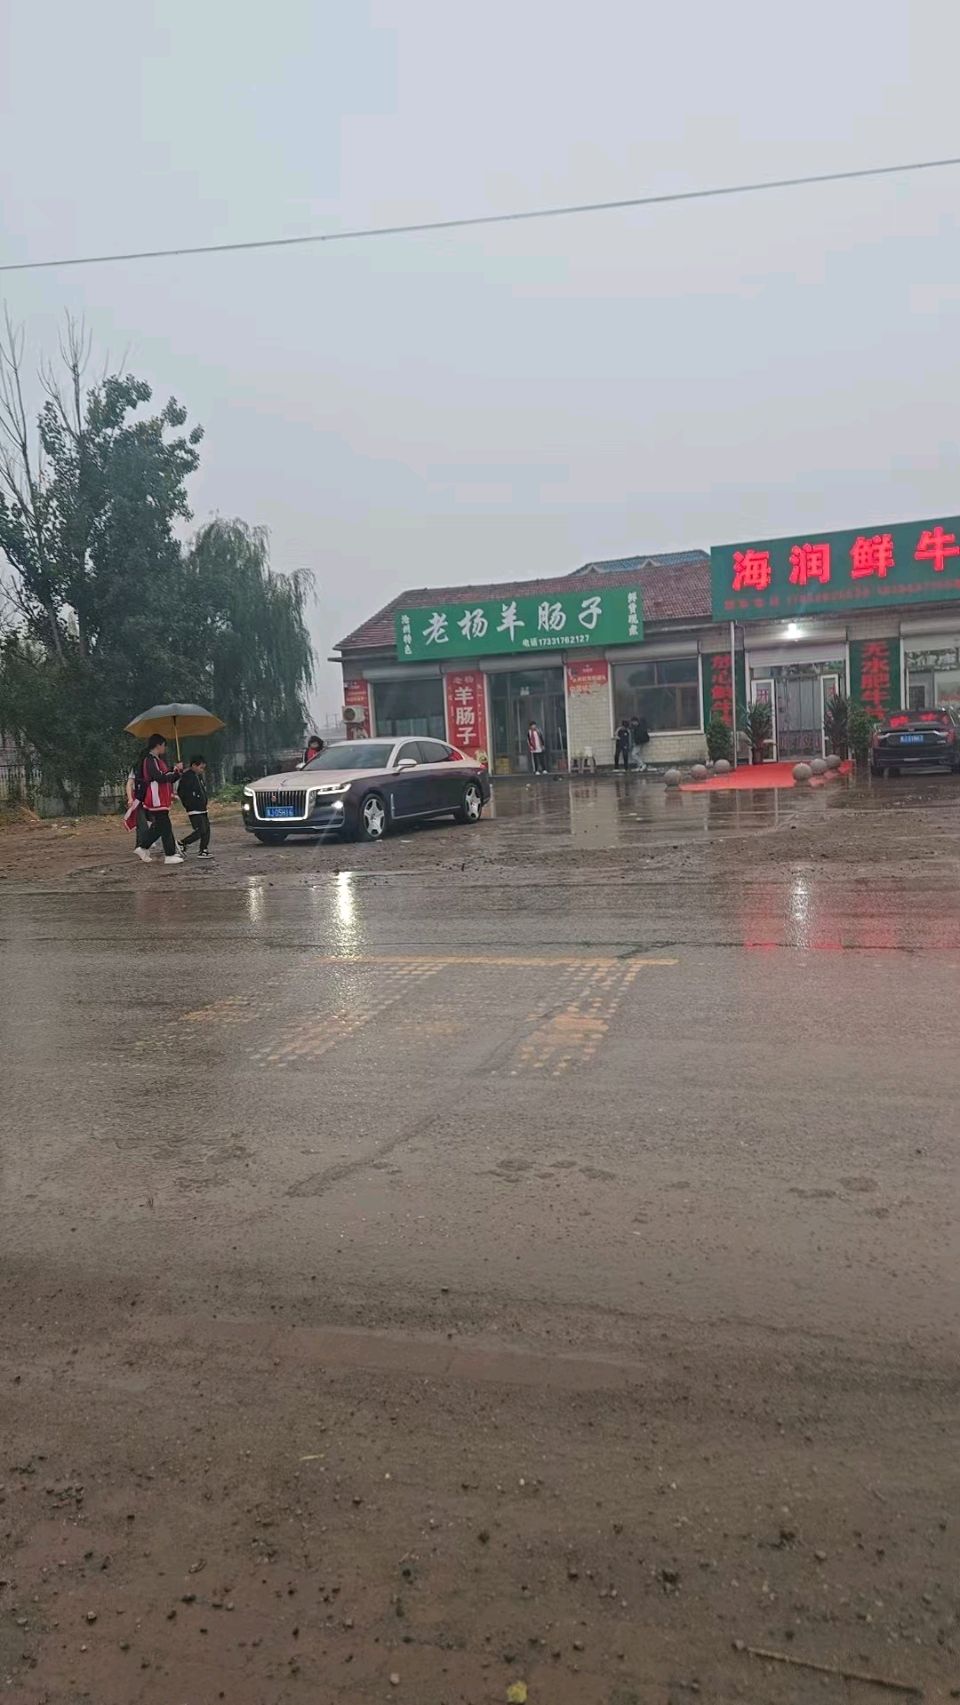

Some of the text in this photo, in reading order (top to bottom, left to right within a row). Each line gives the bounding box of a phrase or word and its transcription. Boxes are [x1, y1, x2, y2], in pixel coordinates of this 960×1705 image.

[732, 526, 960, 592] 海润鲜牛
[423, 596, 602, 645] 老杨羊肠子
[454, 686, 477, 745] 羊肠子
